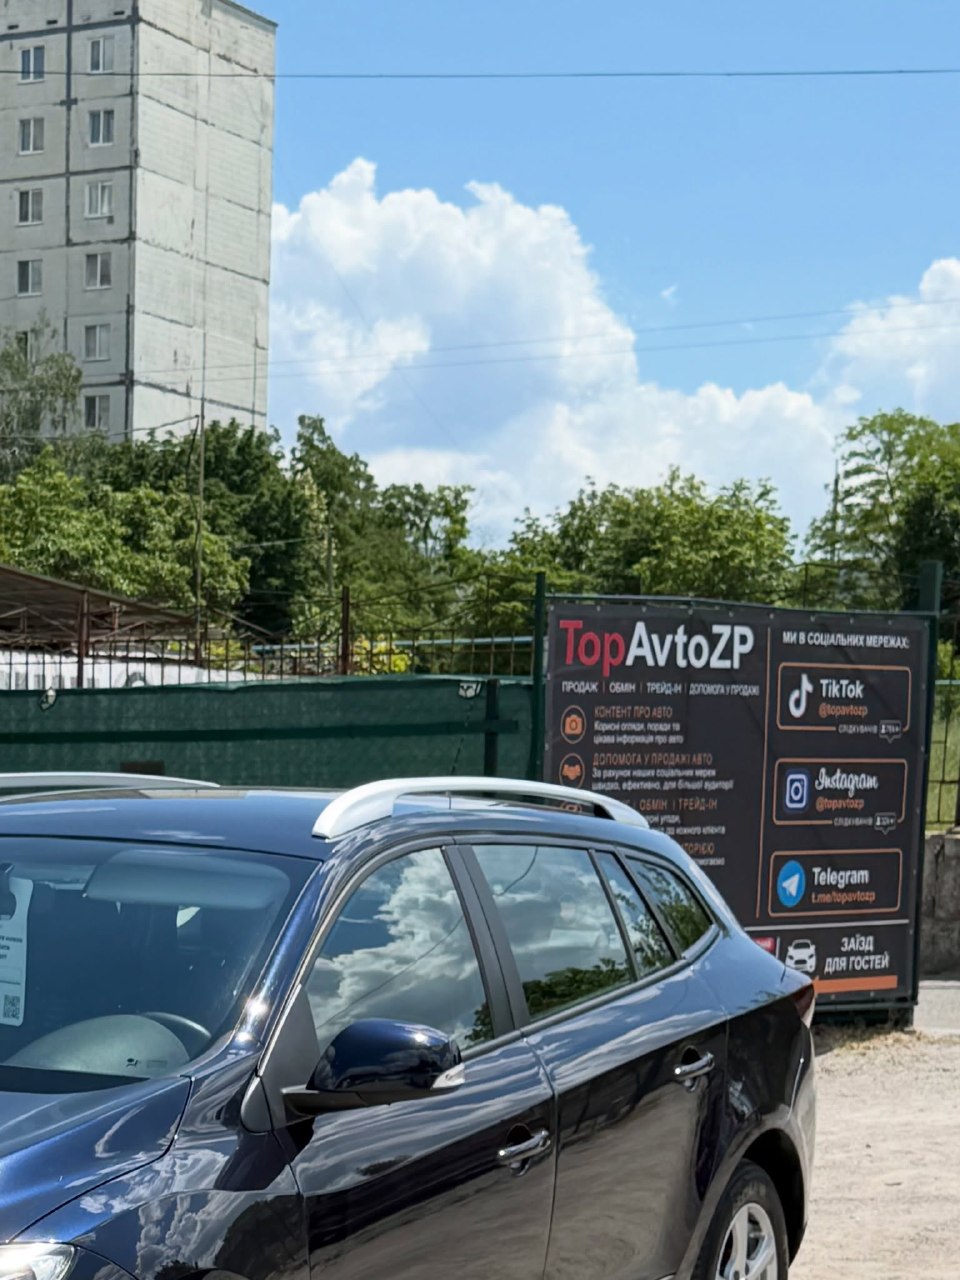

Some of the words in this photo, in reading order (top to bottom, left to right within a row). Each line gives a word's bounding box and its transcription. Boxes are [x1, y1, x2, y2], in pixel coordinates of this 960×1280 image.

[782, 631, 797, 644] МИ
[799, 632, 806, 645] В
[807, 633, 864, 647] СОЦІАЛЬНИХ
[559, 620, 754, 677] TopAvtoZP
[562, 681, 598, 695] ПРОДАЖ
[609, 682, 636, 694] ОБМІН
[646, 681, 682, 695] ТРЕЙД-ІН
[820, 679, 864, 698] TikTok
[594, 706, 632, 719] КОНТЕНТ
[633, 706, 651, 718] ПРО
[652, 706, 673, 719] АВТО
[593, 752, 642, 766] ДОПОМОГА
[692, 753, 713, 766] АВТО
[815, 767, 879, 798] Instagram
[640, 799, 667, 811] ОБМІН
[812, 867, 869, 889] Telegram
[841, 933, 874, 952] ЗАЇЗД
[824, 955, 846, 975] ДЛЯ
[849, 950, 889, 971] ГОСТЕЙ
